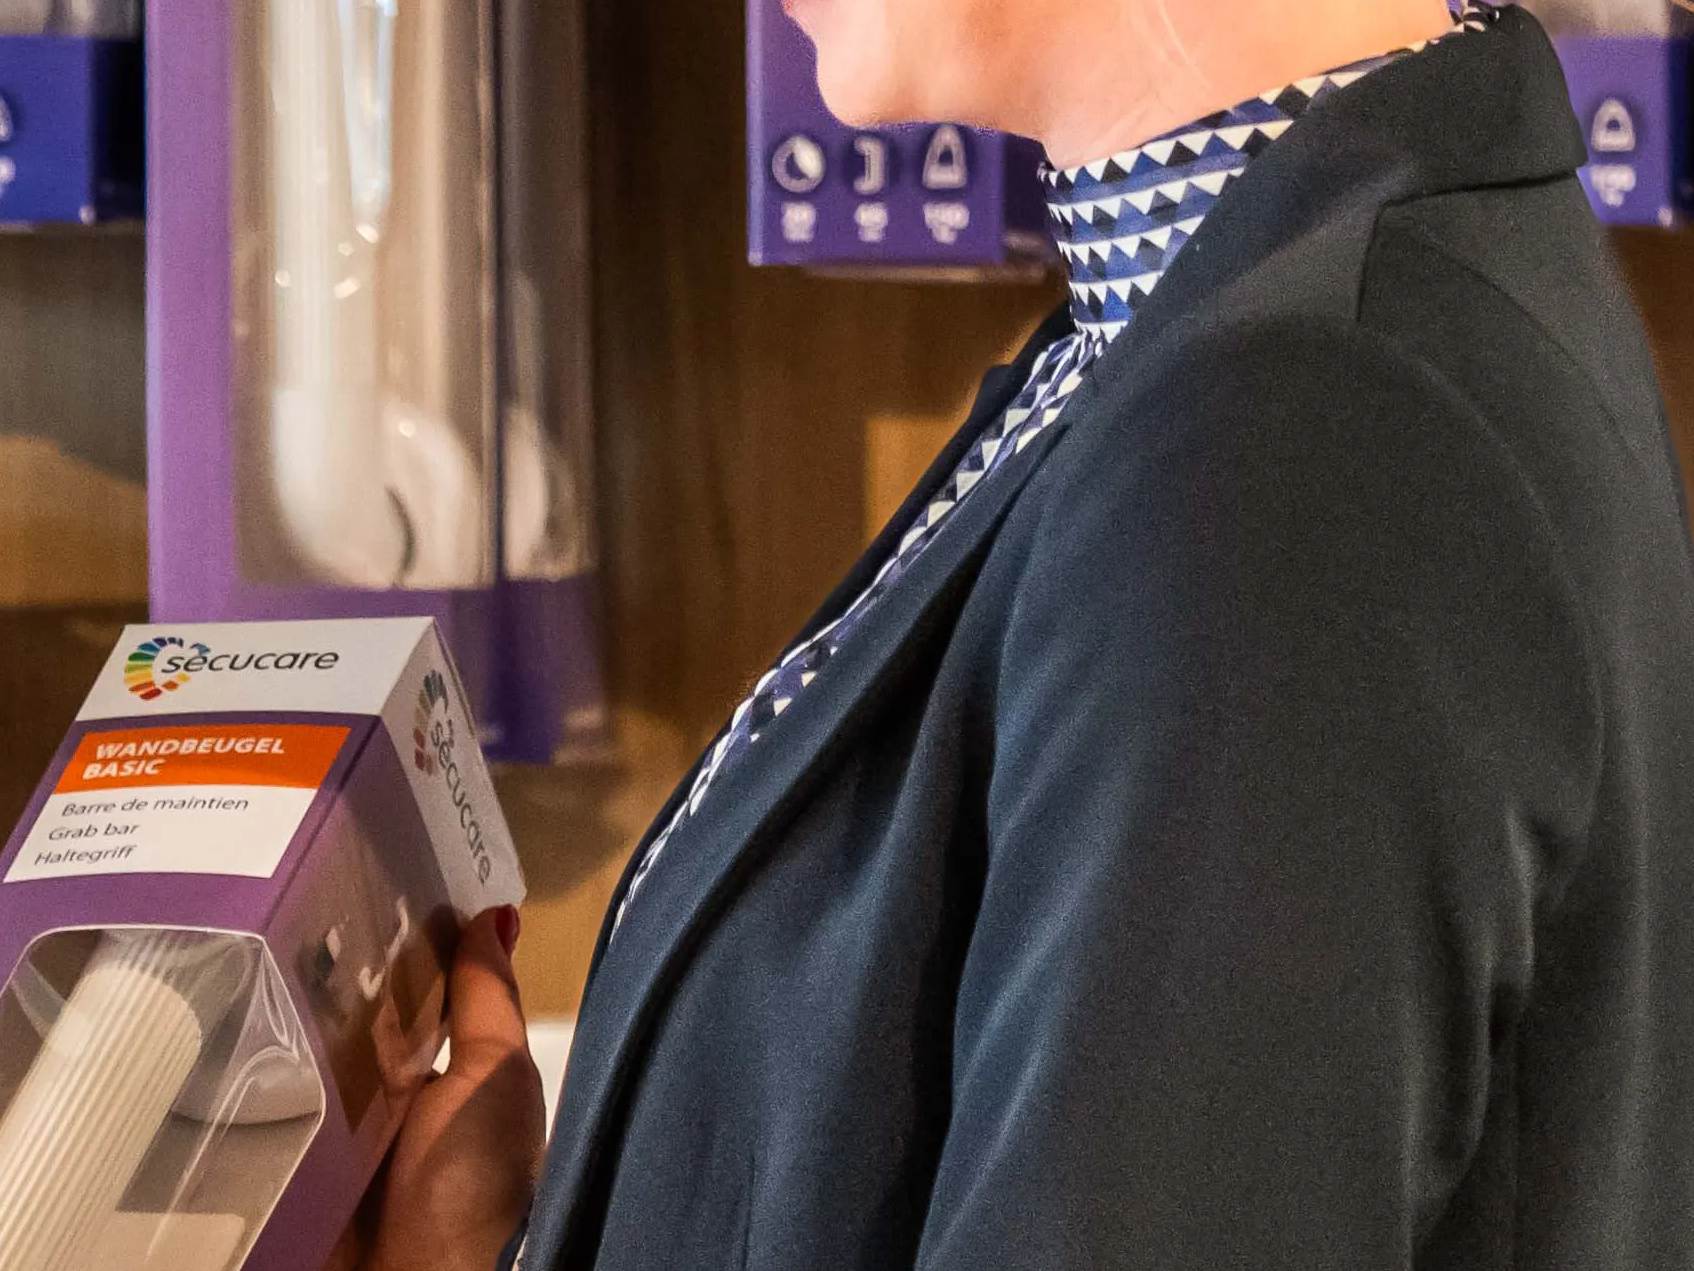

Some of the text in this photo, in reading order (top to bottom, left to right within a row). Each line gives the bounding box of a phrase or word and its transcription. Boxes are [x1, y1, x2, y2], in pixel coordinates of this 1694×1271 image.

[161, 648, 340, 674] secucare
[96, 737, 285, 760] WANDBEUGEL
[82, 760, 162, 780] BASIC
[61, 797, 250, 817] Barre de maintien
[431, 720, 492, 886] secucare
[48, 822, 140, 841] Grab bar
[34, 844, 137, 866] Haltegriff
